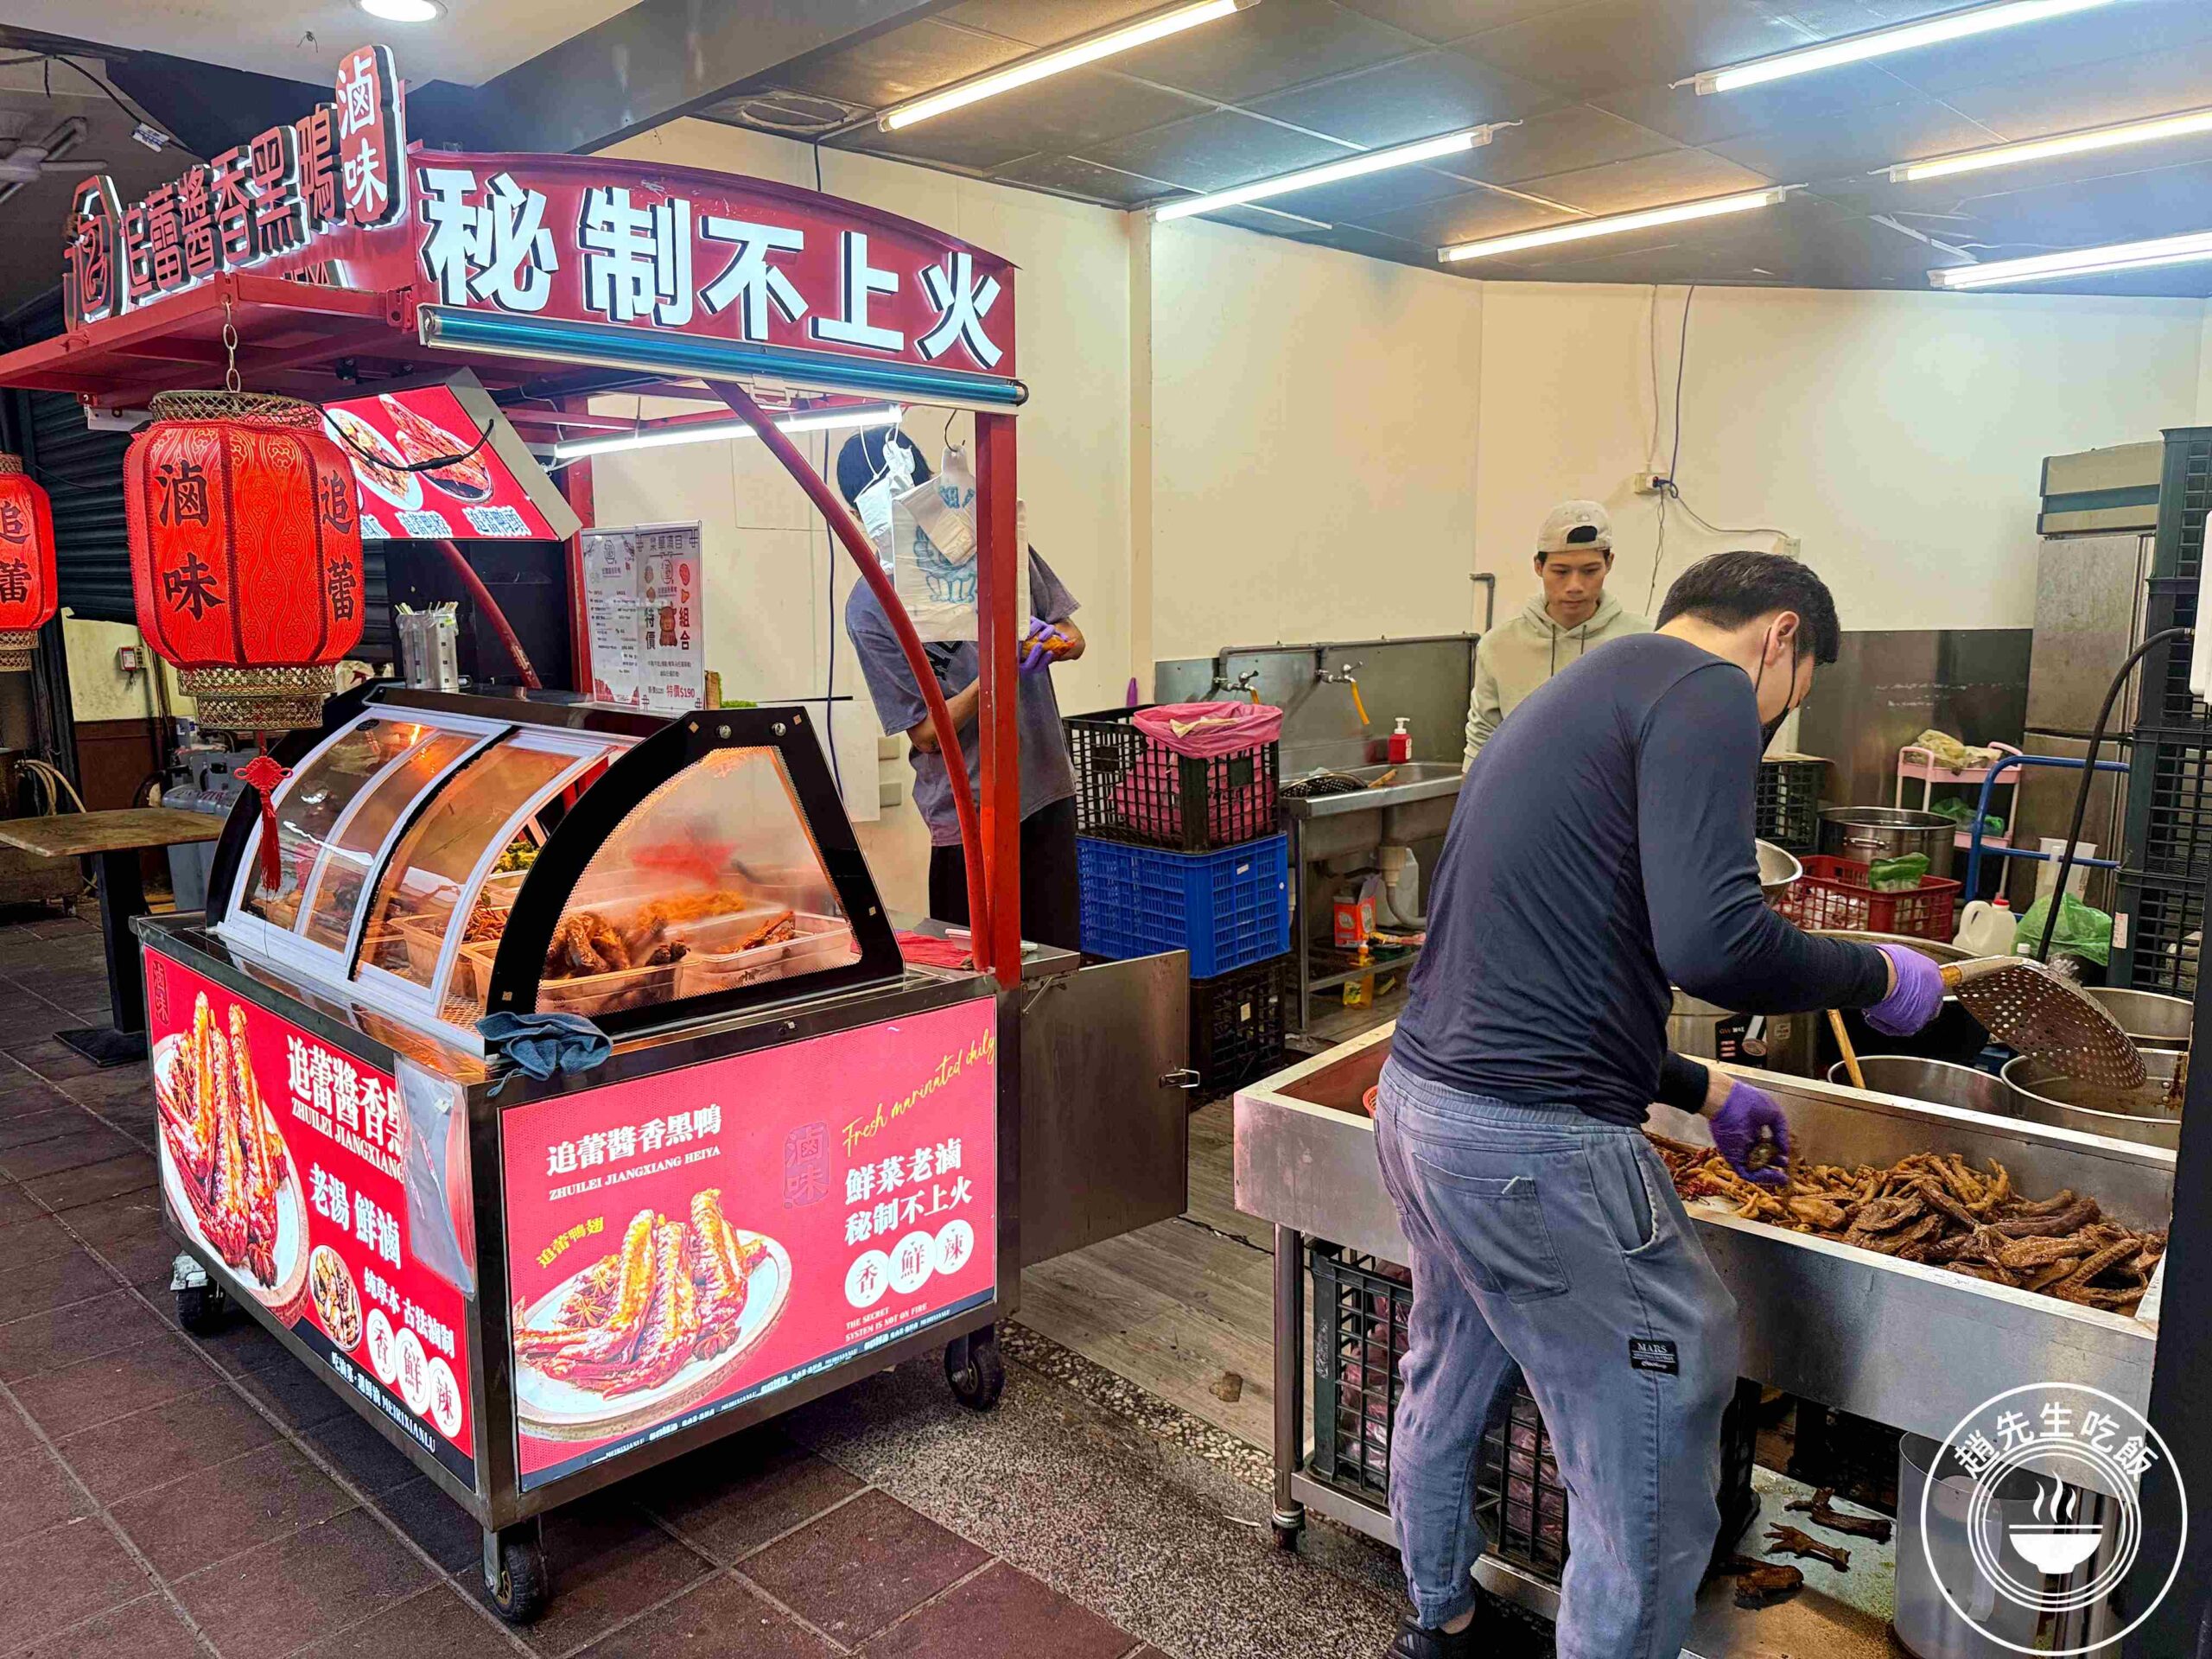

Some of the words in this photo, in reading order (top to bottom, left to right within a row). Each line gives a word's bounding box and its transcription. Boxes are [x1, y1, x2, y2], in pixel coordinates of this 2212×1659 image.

[338, 54, 388, 213] 滷味
[418, 168, 1004, 370] 秘制不上火
[158, 459, 225, 621] 滷味
[320, 469, 355, 621] 追蕾
[679, 607, 690, 650] 組合
[292, 1096, 334, 1139] ZHUILEI
[842, 1103, 887, 1158] Fresh
[891, 1049, 963, 1119] marinated
[546, 1103, 722, 1176] 追蕾醬香黑鴨
[549, 1177, 603, 1201] ZHUILEI
[605, 1156, 683, 1185] JIANGXIANG
[684, 1146, 721, 1165] HEIYA
[785, 1122, 830, 1203] 滷味
[845, 1138, 963, 1205] 鮮菜老滷
[309, 1162, 350, 1231] 老湯
[354, 1190, 401, 1269] 鮮滷
[845, 1176, 973, 1246] 秘制不上火
[846, 1318, 861, 1331] THE
[862, 1306, 890, 1323] SECRET
[875, 1320, 883, 1331] IS
[884, 1313, 899, 1326] NOT
[911, 1302, 927, 1315] FIRE
[1637, 1342, 1668, 1353] MARS
